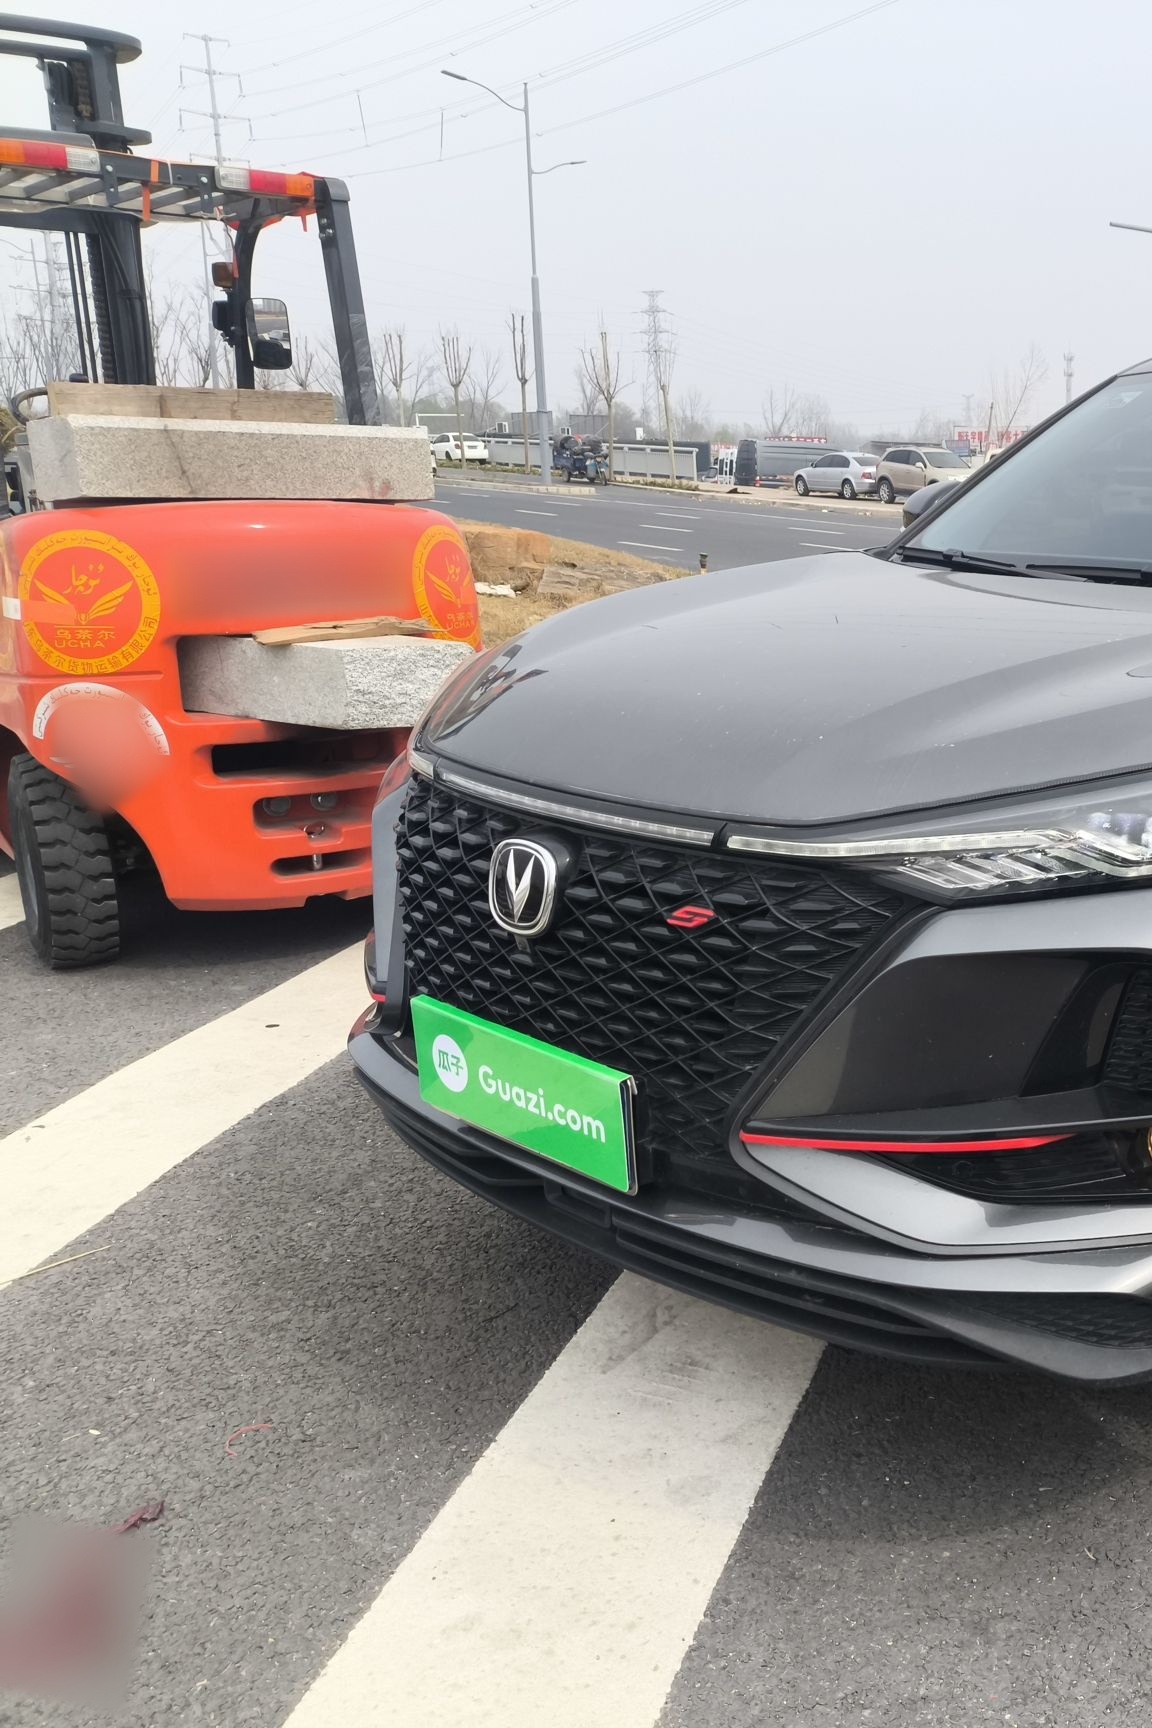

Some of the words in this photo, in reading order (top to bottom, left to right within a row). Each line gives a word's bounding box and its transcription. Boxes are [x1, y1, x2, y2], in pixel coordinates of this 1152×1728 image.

[54, 639, 106, 649] UCHA
[438, 1049, 464, 1076] 瓜子
[478, 1065, 606, 1143] Guazi.com
